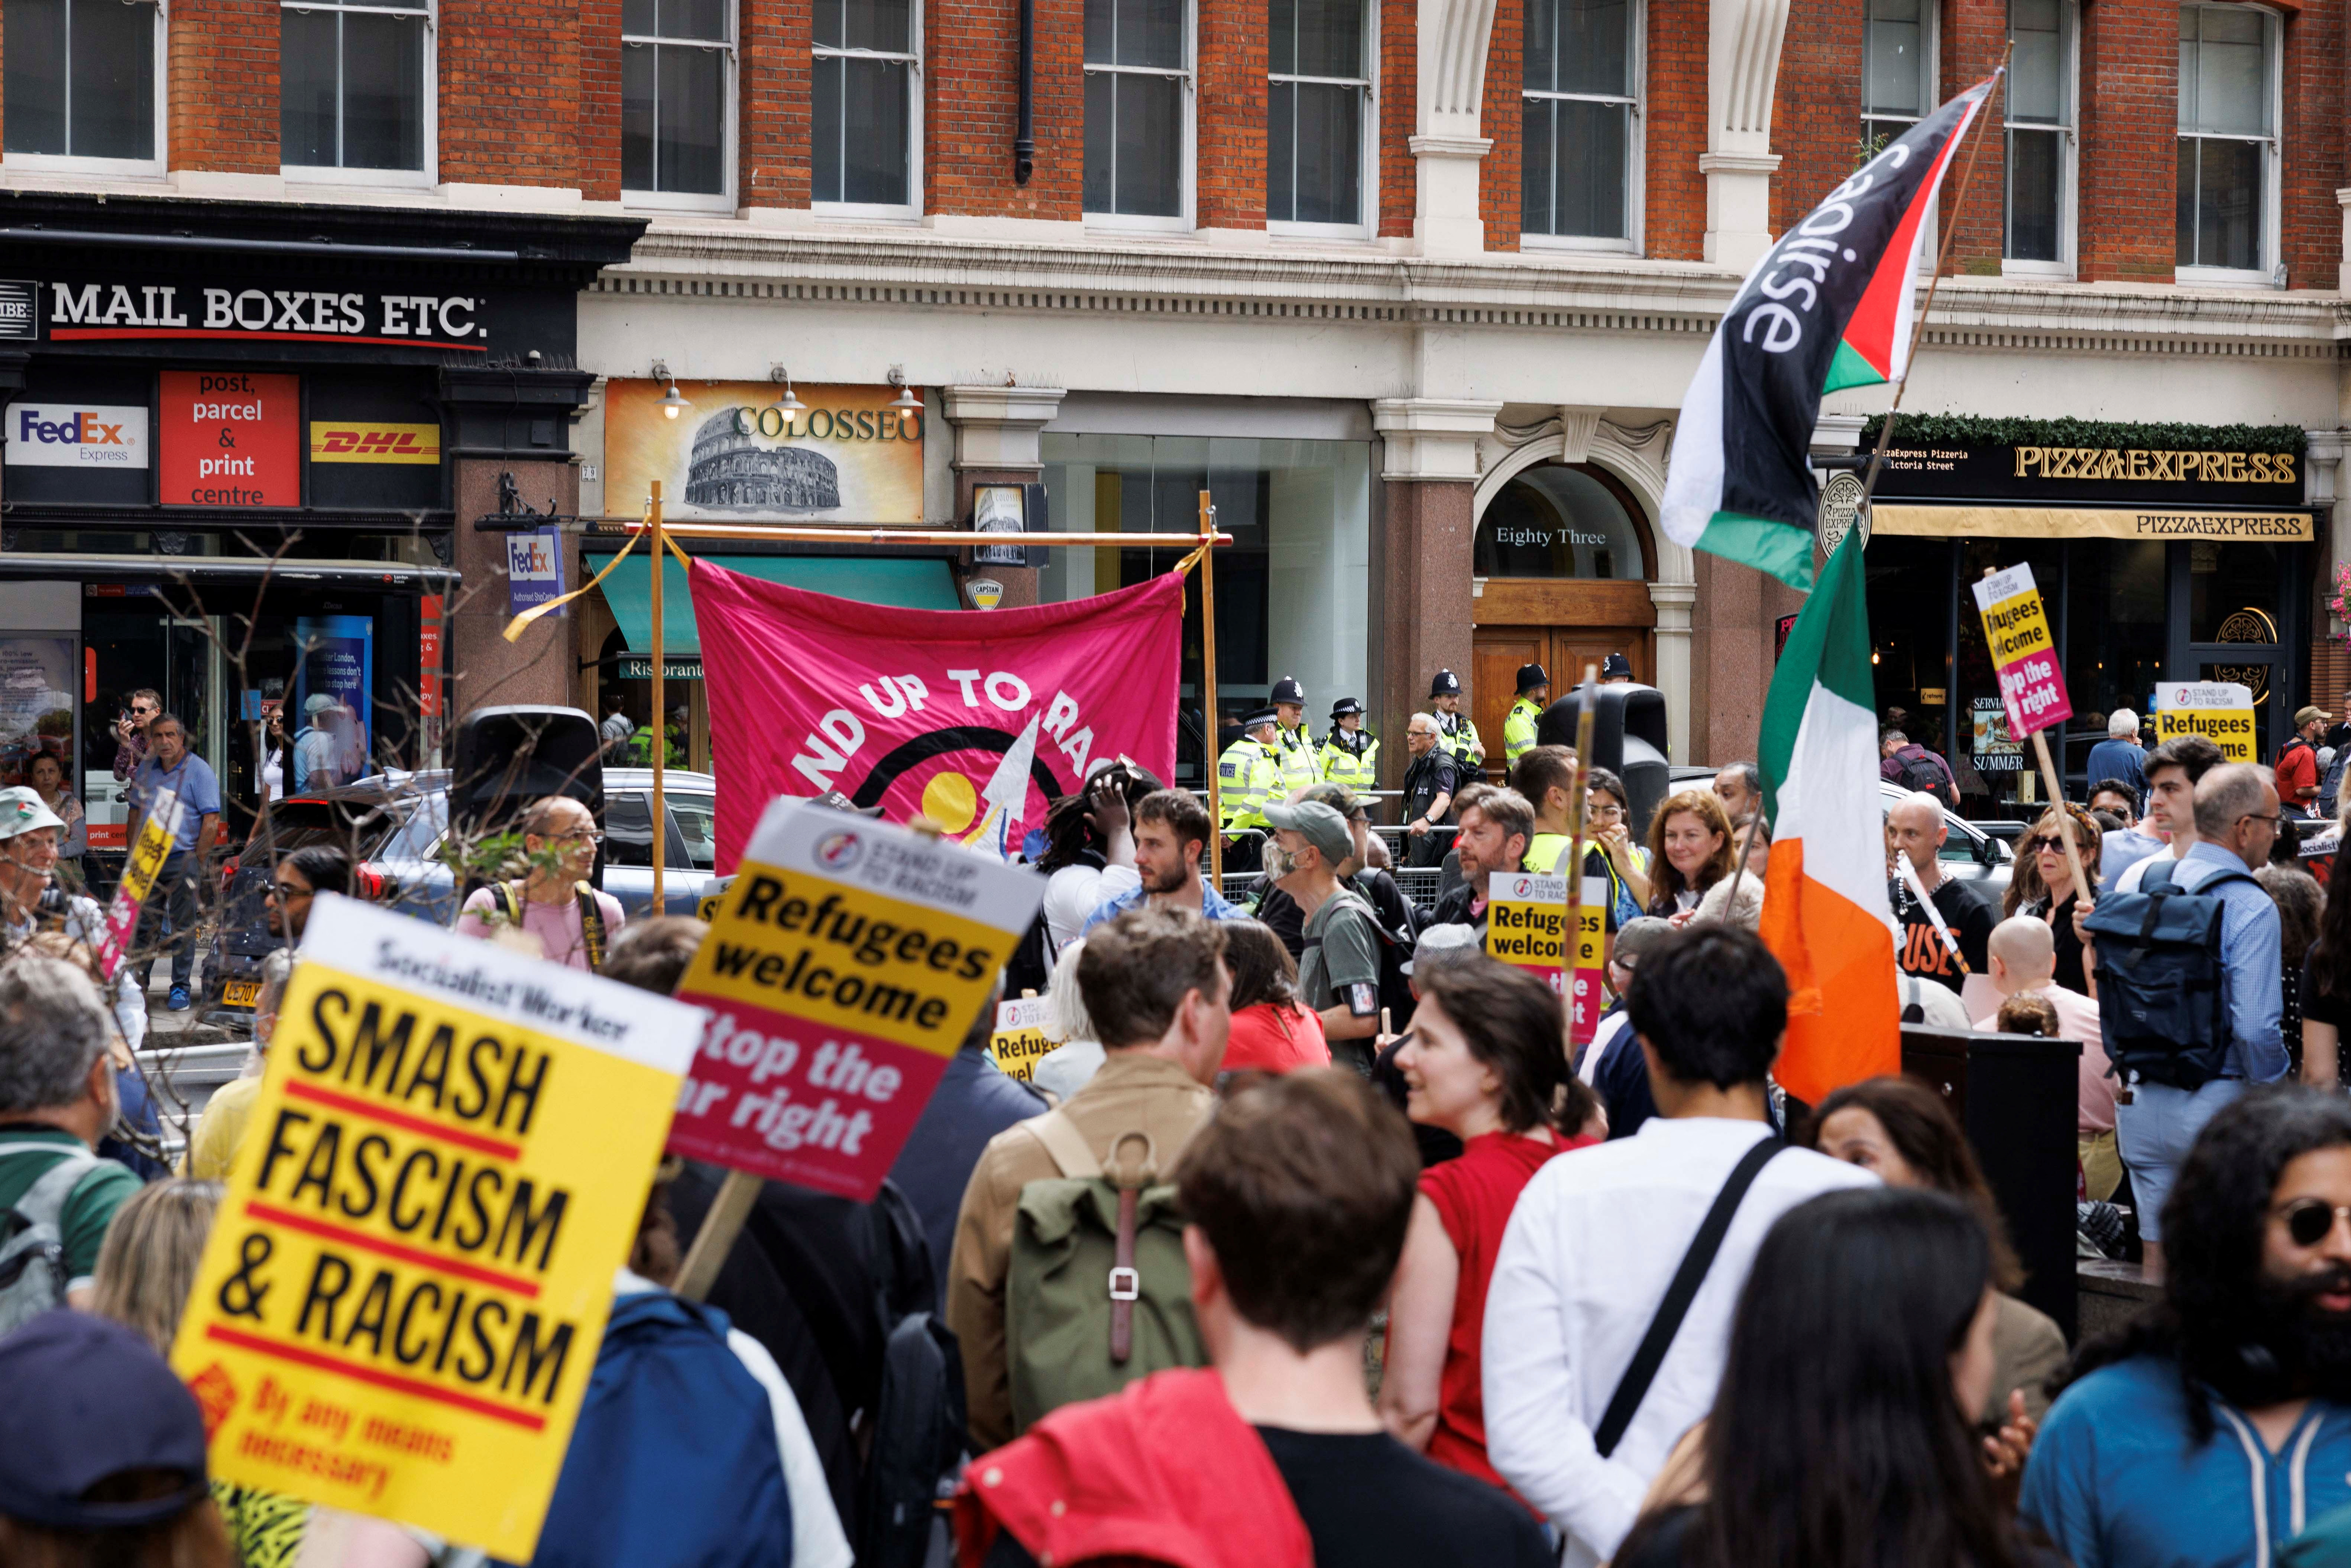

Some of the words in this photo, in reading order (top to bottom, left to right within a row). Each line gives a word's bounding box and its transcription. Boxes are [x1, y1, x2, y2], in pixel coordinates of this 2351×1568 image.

[0, 302, 26, 318] BE
[52, 282, 187, 327] MAIL
[203, 289, 365, 334] BOXES
[381, 295, 487, 337] ETC.
[200, 375, 256, 394] post,
[193, 400, 262, 422] parcel
[20, 410, 123, 445] FedEx
[734, 406, 924, 441] COLOSSEO
[218, 428, 236, 448] &
[322, 432, 424, 454] DHL
[80, 447, 128, 462] Express
[1873, 448, 1927, 459] PzzaExpress
[1931, 449, 1968, 459] Pizzeria
[199, 454, 255, 478] print
[1890, 460, 1922, 470] ictoria
[1927, 461, 1954, 470] Street
[2015, 447, 2296, 483] PIZZAEXPRESS
[191, 486, 264, 505] centre
[995, 493, 1022, 502] COLOSSEO
[1833, 508, 1856, 518] PIZZA
[1826, 518, 1863, 529] EXPRES
[2137, 516, 2302, 536] PIZZAEXPRESS
[1496, 527, 1552, 547] Eighty
[1558, 528, 1606, 545] Three
[511, 542, 548, 573] FedEx
[514, 592, 534, 602] Authorised
[976, 584, 999, 594] CAPSTAN
[426, 642, 433, 651] &
[334, 652, 356, 664] London,
[346, 666, 361, 677] don't
[630, 661, 704, 677] Risorant
[2024, 661, 2052, 684] the
[330, 679, 343, 691] stop
[344, 679, 357, 689] here
[2218, 689, 2229, 697] UP
[2021, 682, 2060, 715] right
[2205, 698, 2234, 706] RACISM
[859, 673, 929, 719] UP
[947, 669, 1032, 711] TO
[1042, 689, 1114, 783] RA
[2162, 714, 2250, 738] Refugees
[1974, 756, 2023, 770] SUMMER
[90, 830, 109, 841] print
[1534, 879, 1563, 890] STAND
[1535, 890, 1545, 899] TO
[1547, 891, 1565, 900] RAC
[736, 874, 995, 982] Refugees
[711, 938, 949, 1030] welcome
[509, 979, 629, 1041] Worker
[297, 987, 551, 1134] SMASH
[700, 1006, 800, 1083] top
[806, 1040, 902, 1102] the
[730, 1087, 874, 1157] right
[256, 1107, 570, 1273] FASCISM
[218, 1232, 274, 1321] &
[294, 1252, 575, 1405] RACISM
[364, 1410, 458, 1463] means
[236, 1427, 393, 1500] necessary
